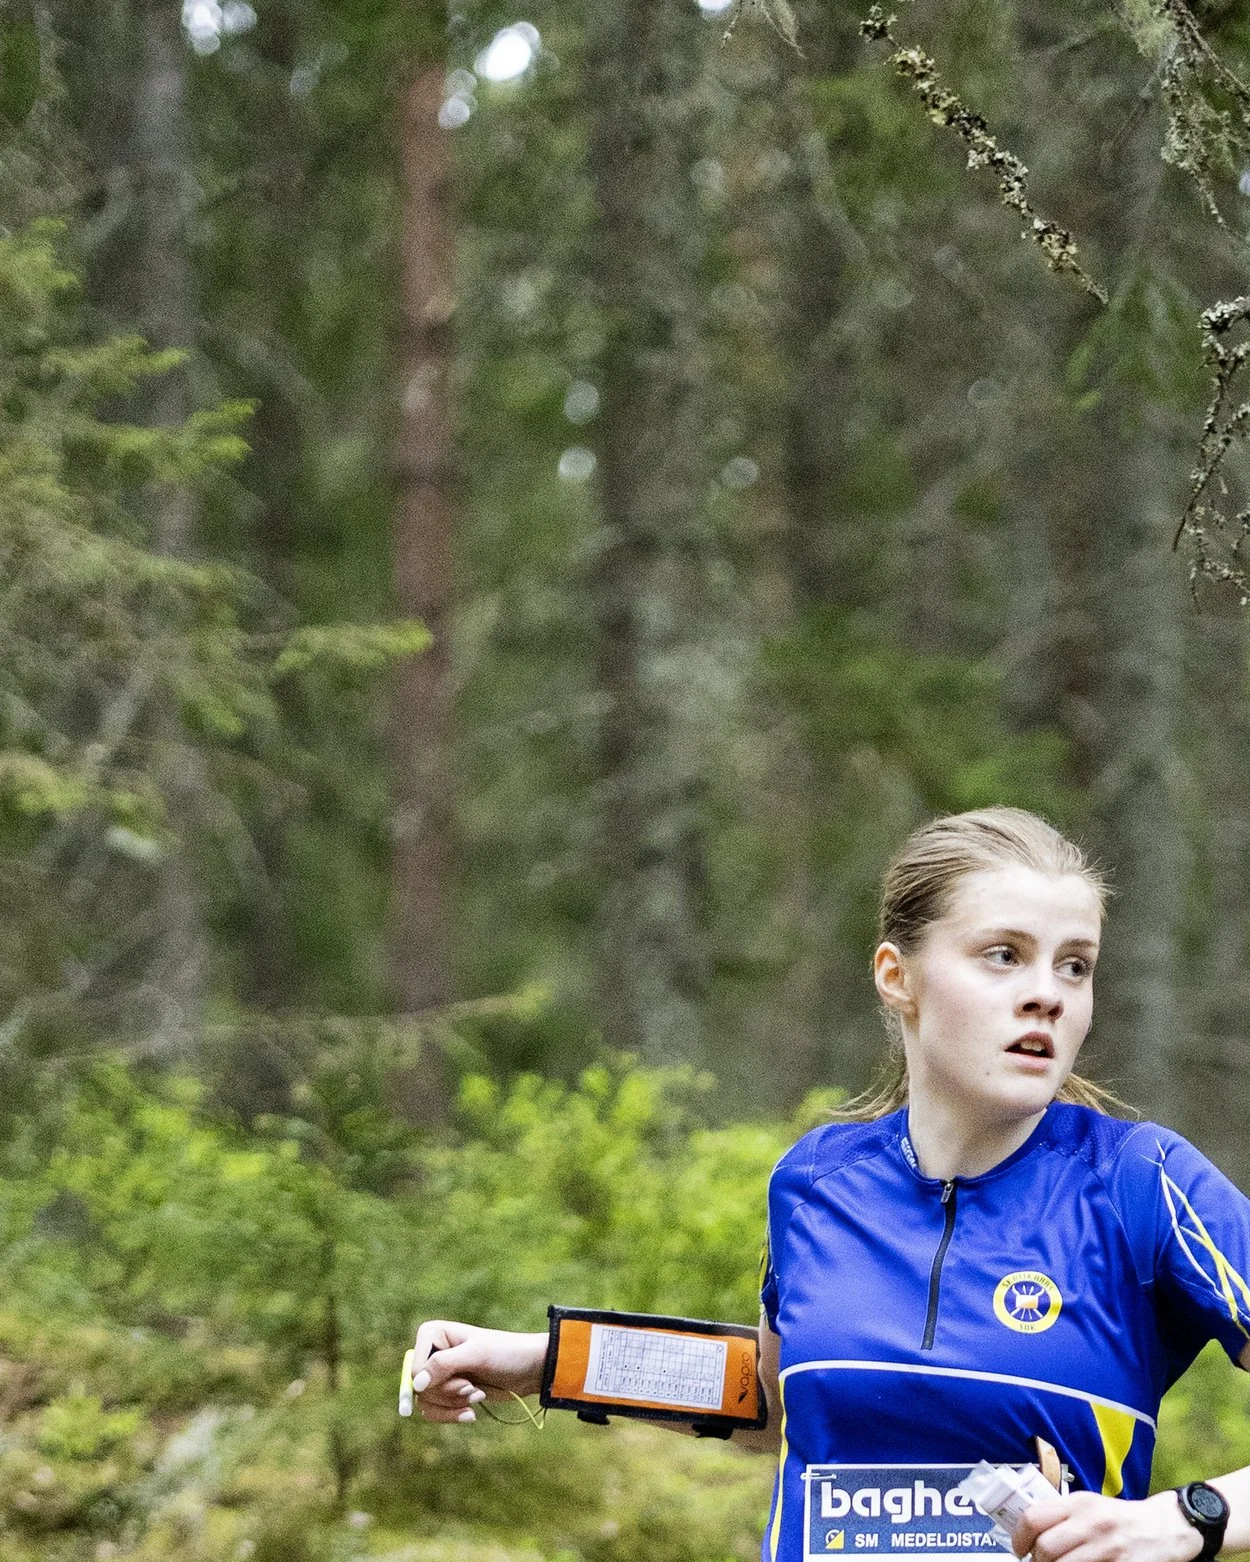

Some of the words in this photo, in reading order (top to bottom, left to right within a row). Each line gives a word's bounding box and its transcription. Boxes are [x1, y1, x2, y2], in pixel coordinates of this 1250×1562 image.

[821, 1480, 992, 1523] baghe
[855, 1533, 878, 1547] SM
[891, 1532, 997, 1548] MEDELDISTA
